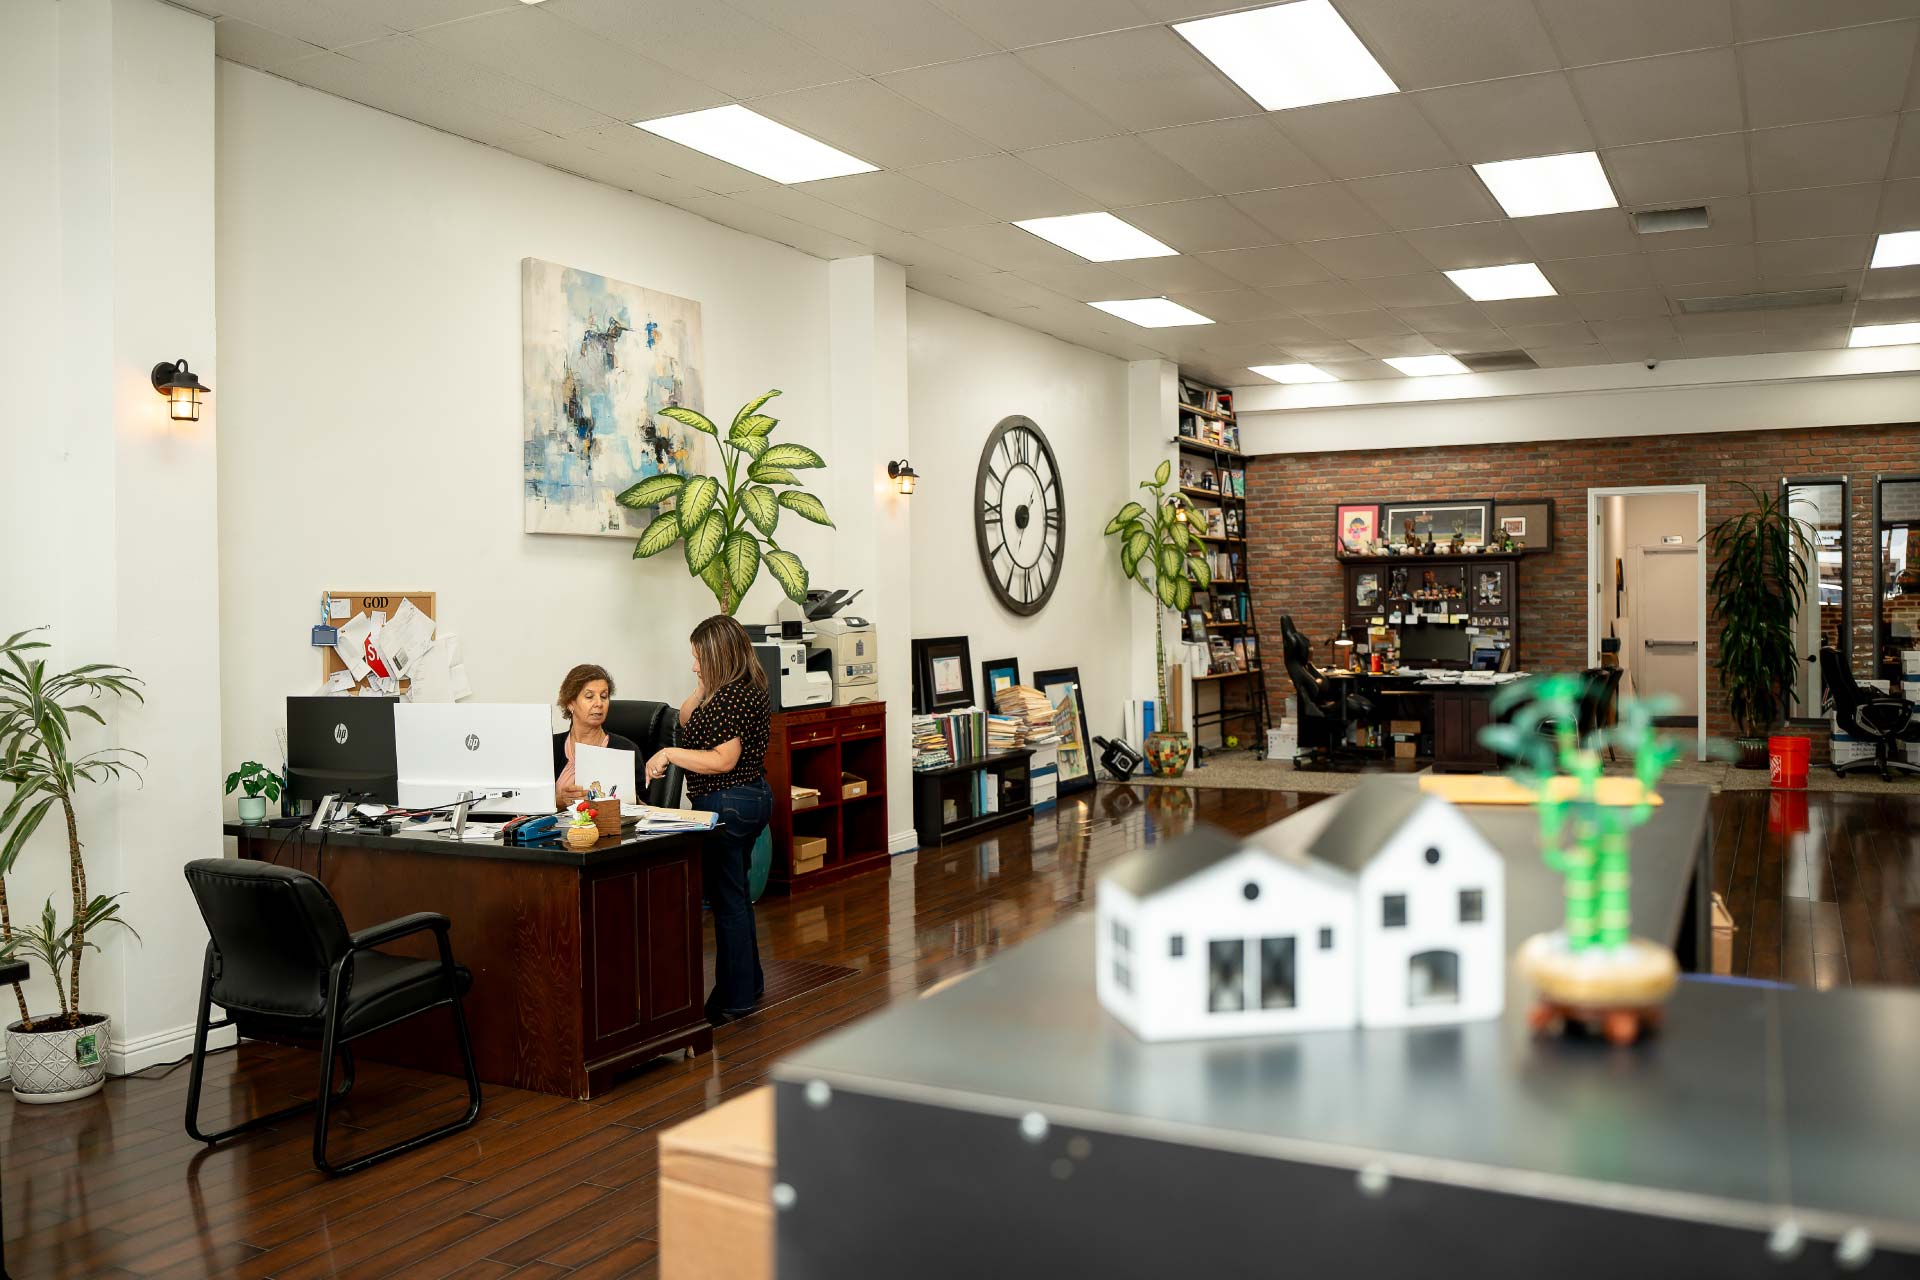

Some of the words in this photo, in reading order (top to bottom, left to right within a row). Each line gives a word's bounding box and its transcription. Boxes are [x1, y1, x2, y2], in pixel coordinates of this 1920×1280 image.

[363, 596, 389, 609] GOD
[336, 723, 347, 744] hp
[467, 734, 479, 750] hp
